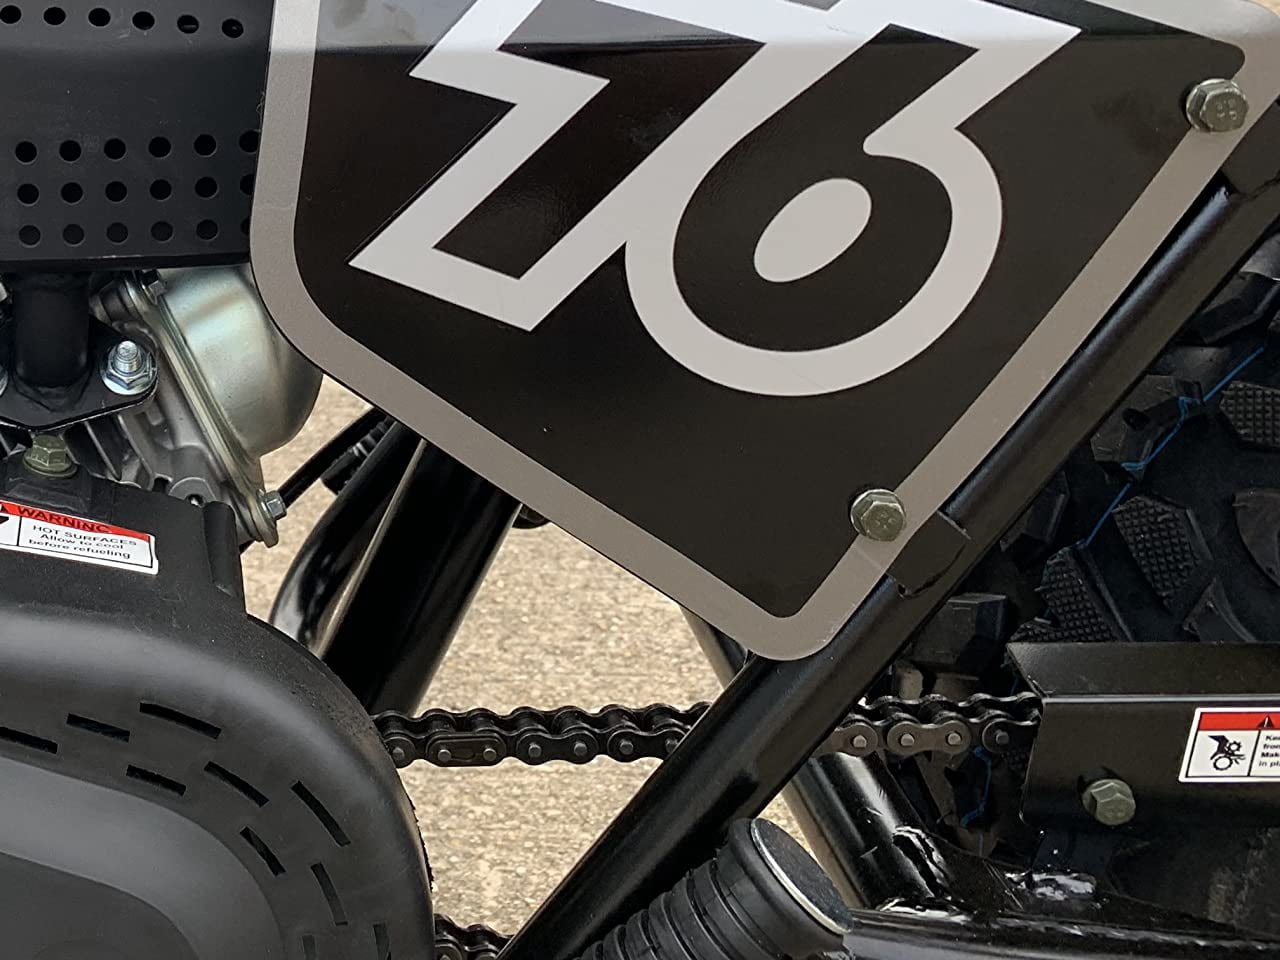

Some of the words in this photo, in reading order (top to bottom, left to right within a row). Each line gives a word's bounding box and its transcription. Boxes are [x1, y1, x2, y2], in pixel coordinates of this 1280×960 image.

[32, 525, 59, 535] HOT
[64, 530, 137, 546] SURFACES
[40, 533, 76, 545] Allow
[79, 537, 90, 546] to
[94, 540, 124, 550] cool
[29, 539, 68, 551] before
[73, 545, 131, 560] refueling
